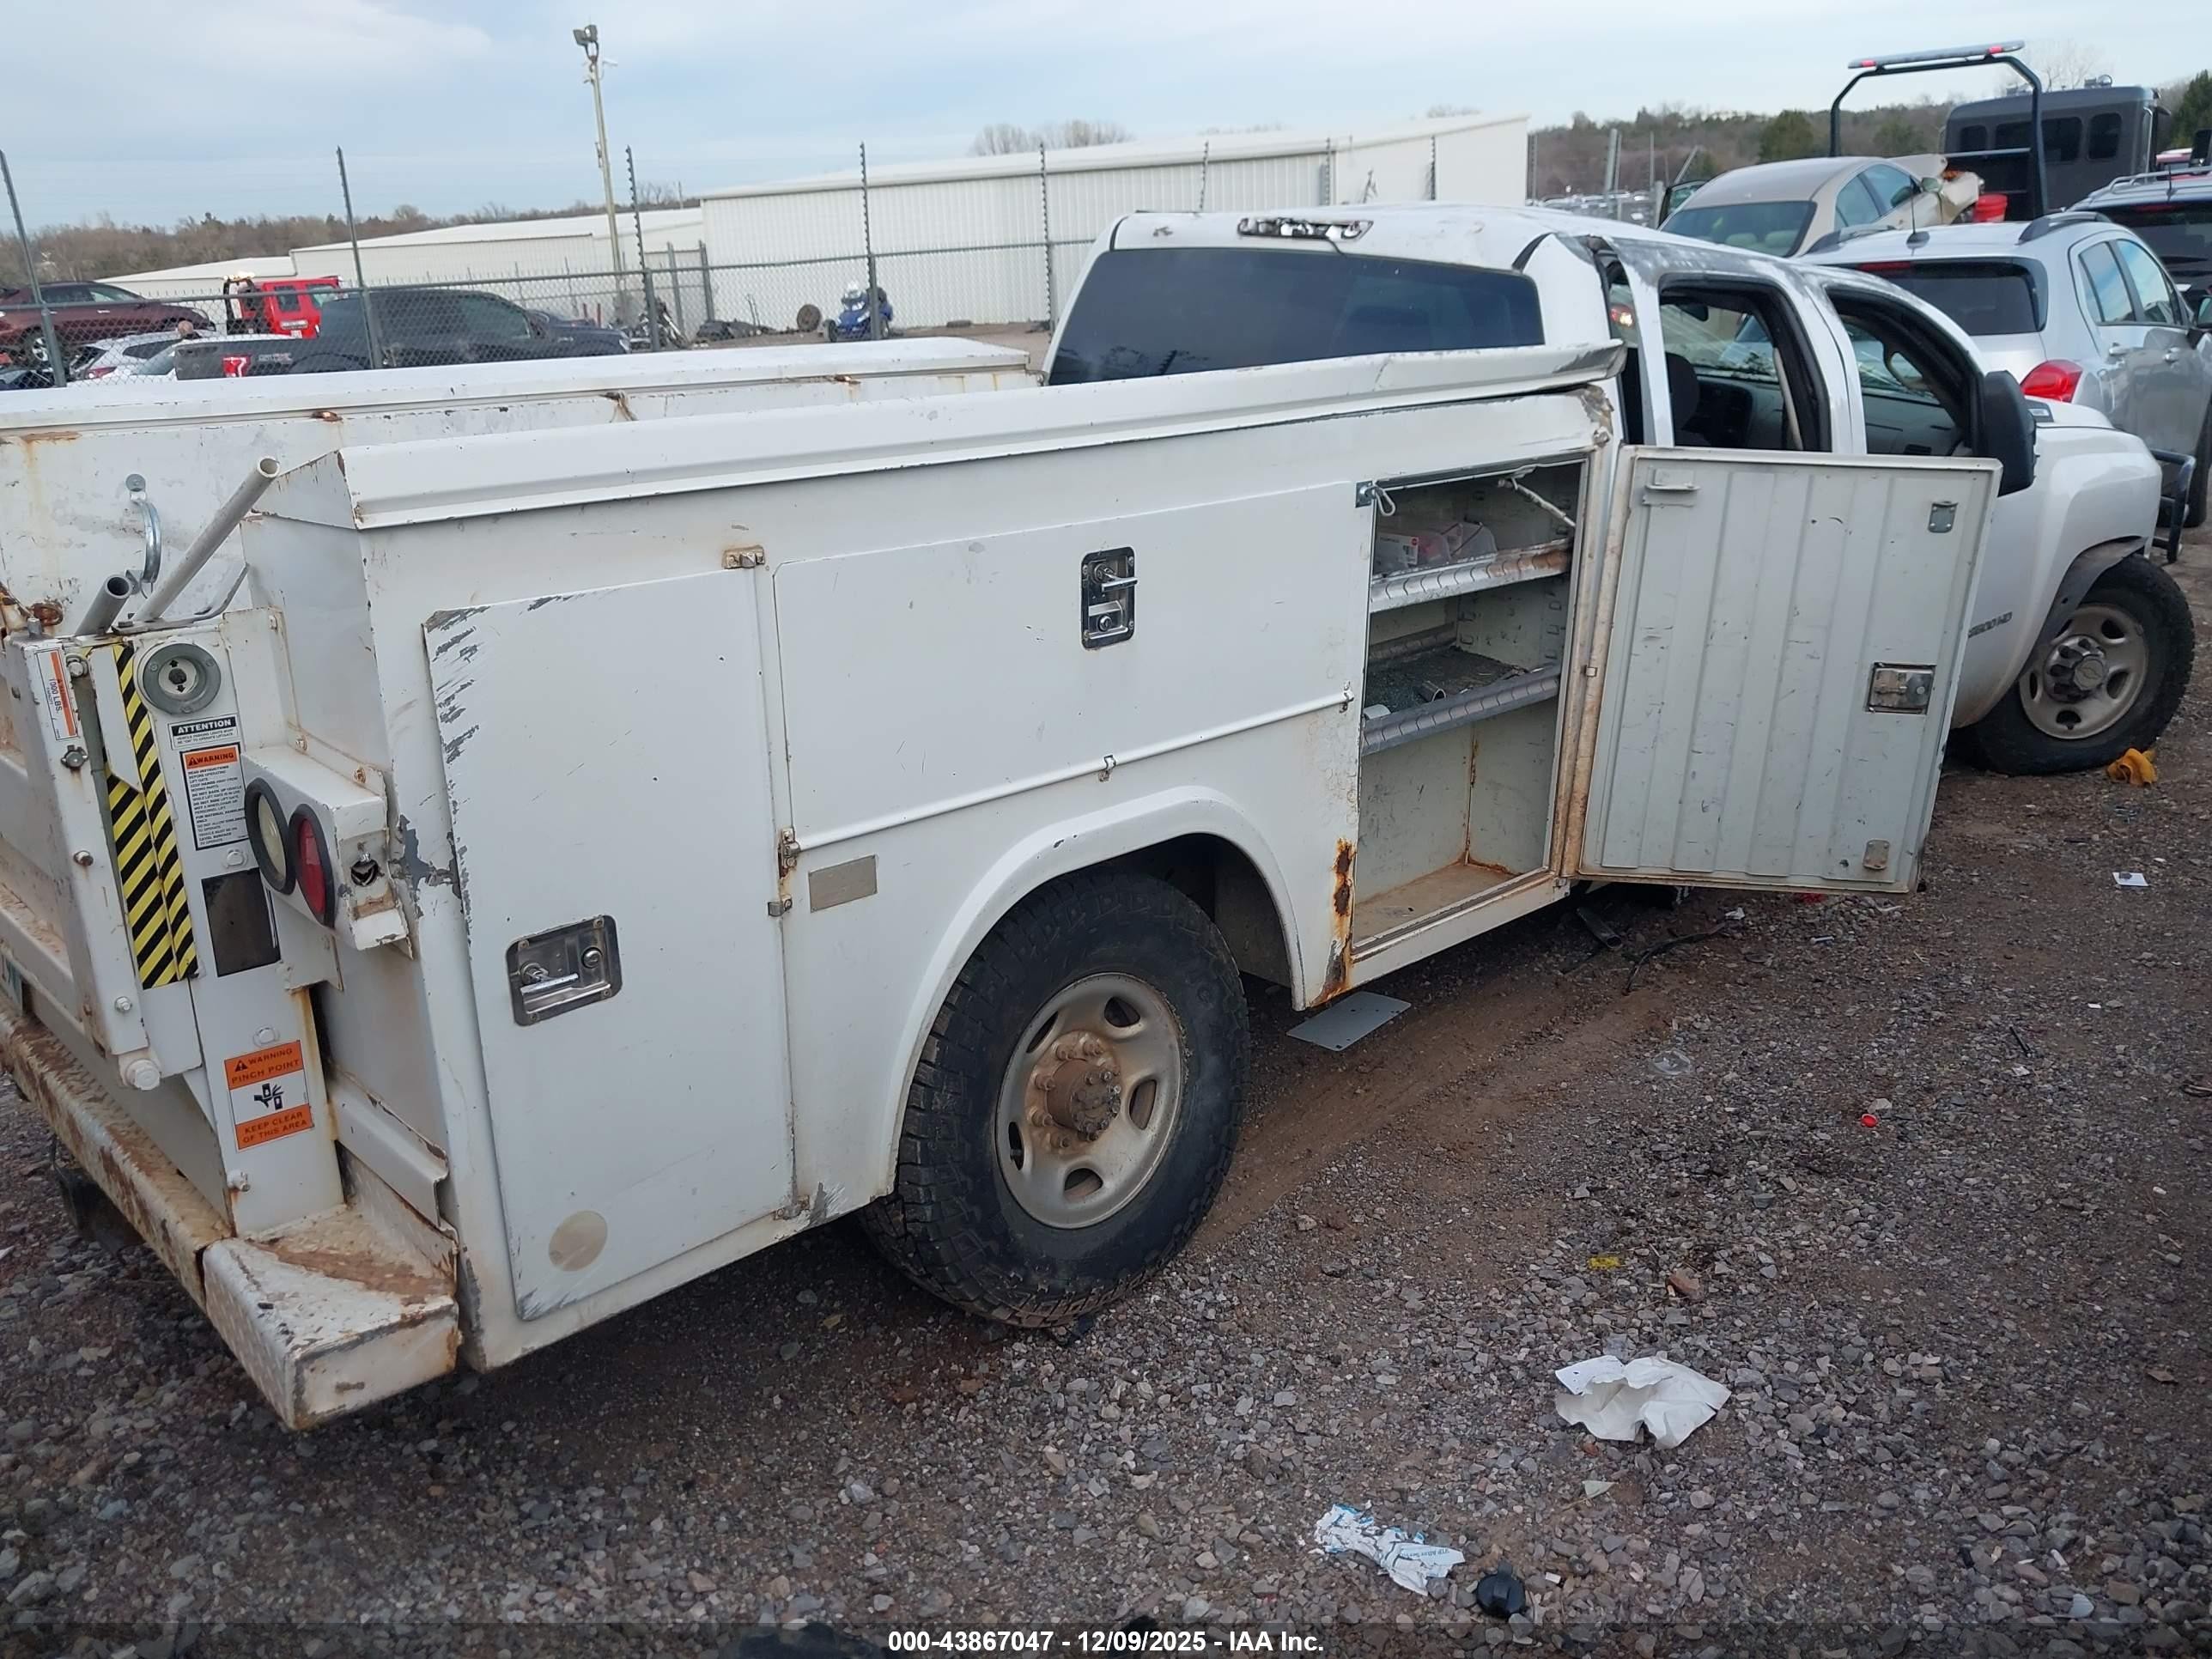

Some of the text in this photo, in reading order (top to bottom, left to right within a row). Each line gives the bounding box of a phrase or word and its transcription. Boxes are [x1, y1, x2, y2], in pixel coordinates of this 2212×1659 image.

[49, 679, 58, 694] 1000
[178, 719, 231, 734] ATTENTION
[197, 752, 234, 763] WARNING
[248, 1048, 292, 1065] WARNING
[232, 1060, 299, 1084] PINCH POINT
[245, 1111, 303, 1133] KEEP CLEAR
[259, 1128, 279, 1138] THIS
[283, 1120, 307, 1129] AREA
